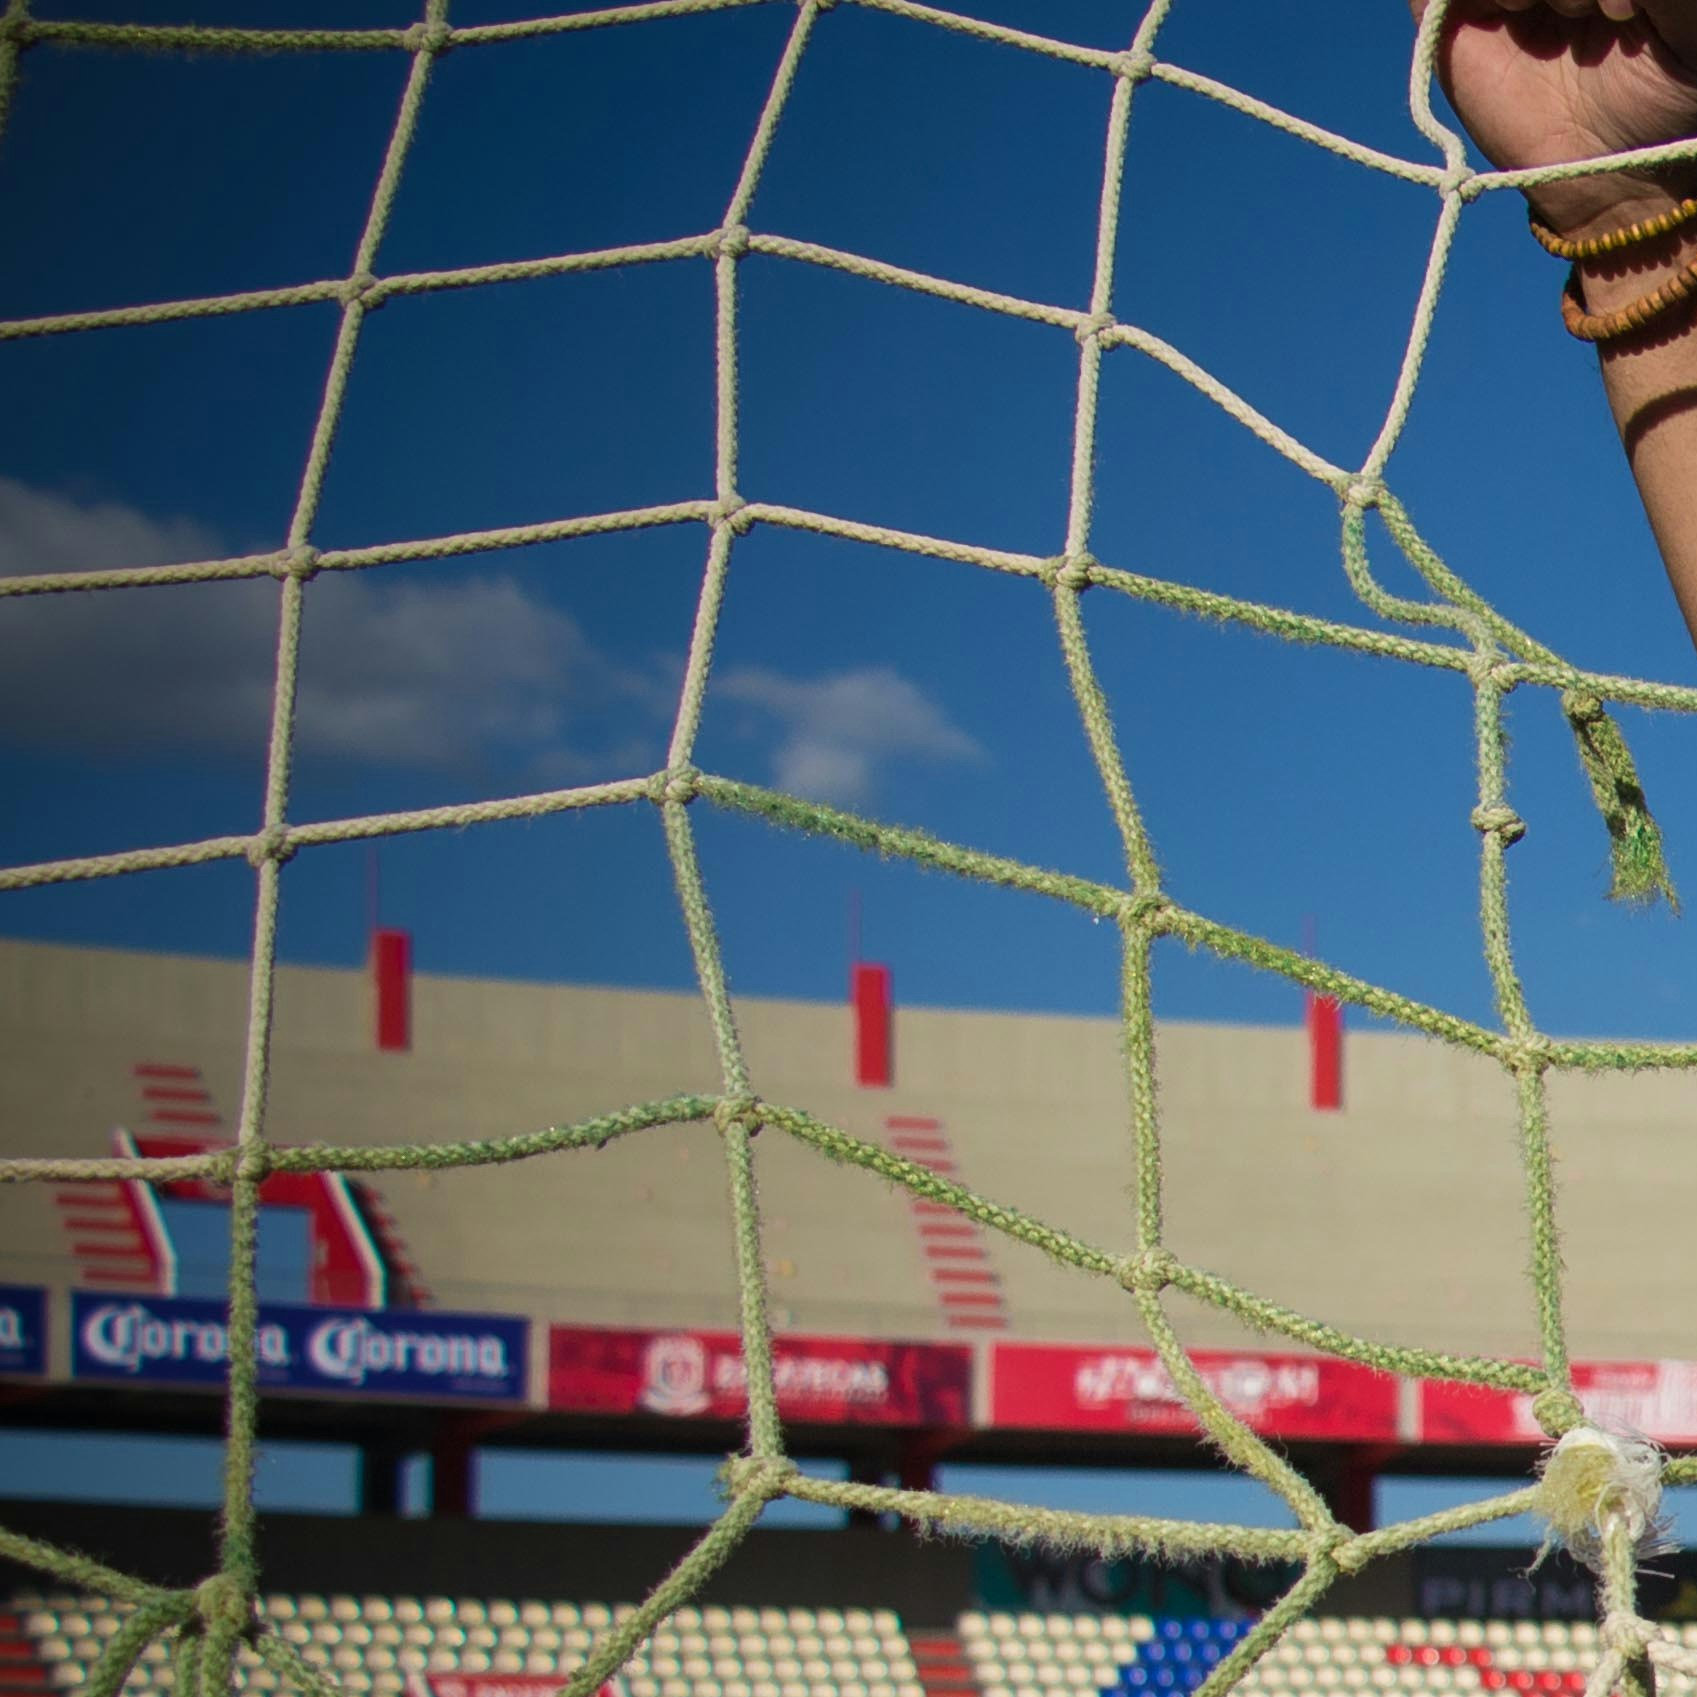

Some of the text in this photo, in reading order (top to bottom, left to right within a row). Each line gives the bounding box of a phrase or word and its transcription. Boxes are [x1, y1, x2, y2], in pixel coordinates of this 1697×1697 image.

[84, 1302, 291, 1374] Coroa
[309, 1315, 509, 1388] Corona
[1420, 1574, 1636, 1622] PIRM
